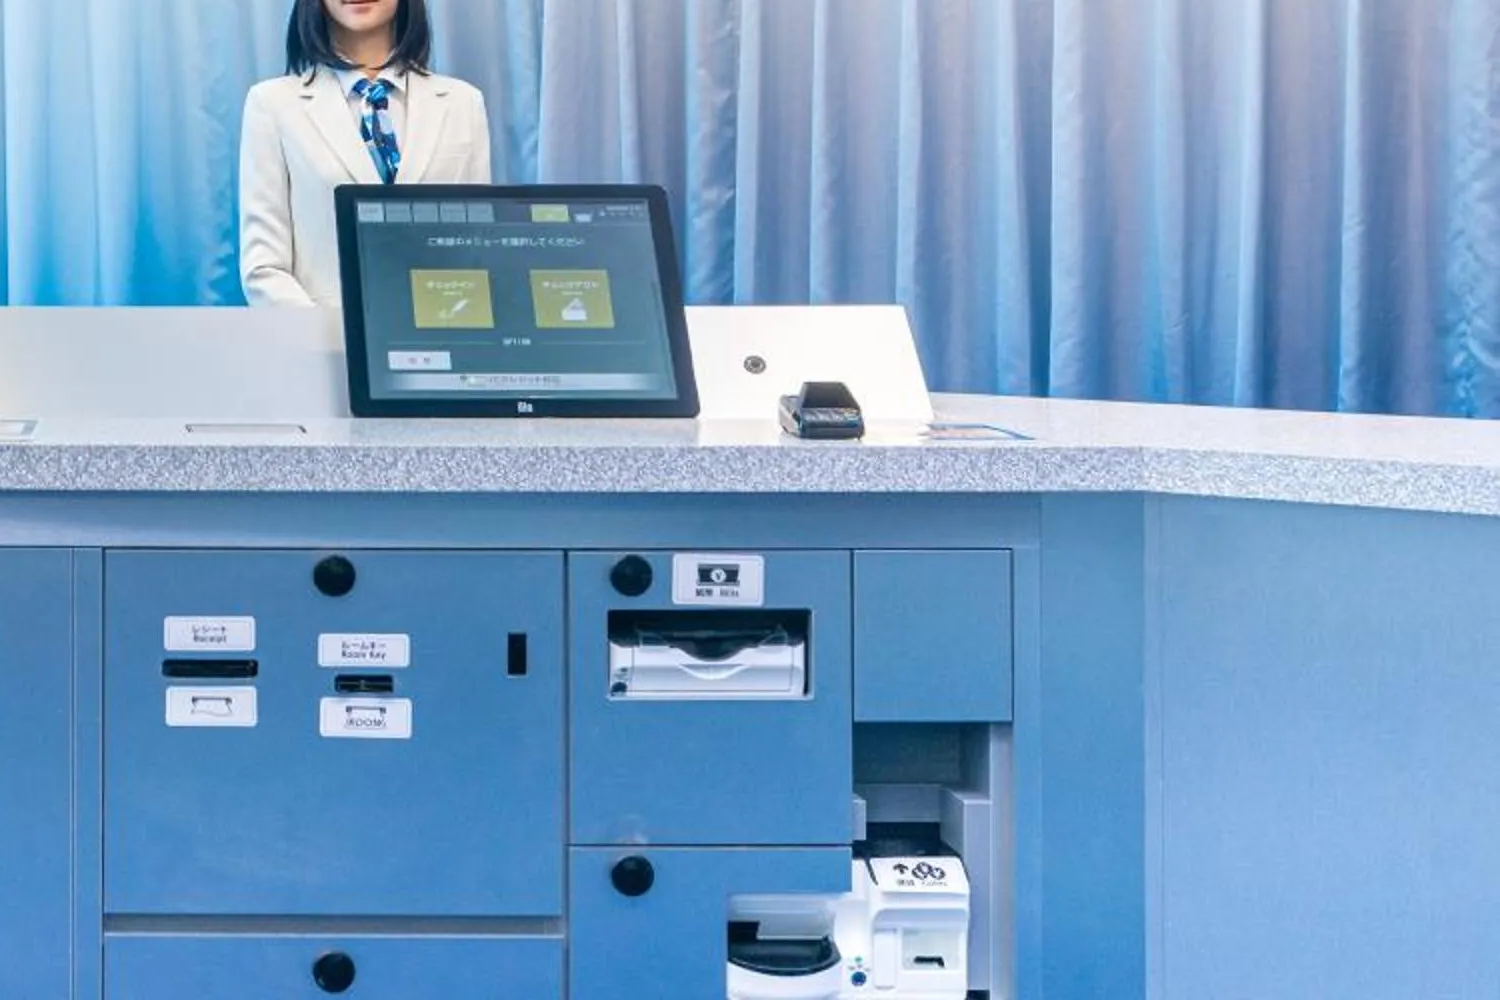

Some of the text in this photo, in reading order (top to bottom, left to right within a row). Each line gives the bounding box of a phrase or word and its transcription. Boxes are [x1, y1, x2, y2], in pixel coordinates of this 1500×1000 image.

[193, 633, 227, 643] Receipt
[341, 650, 386, 661] Room Key
